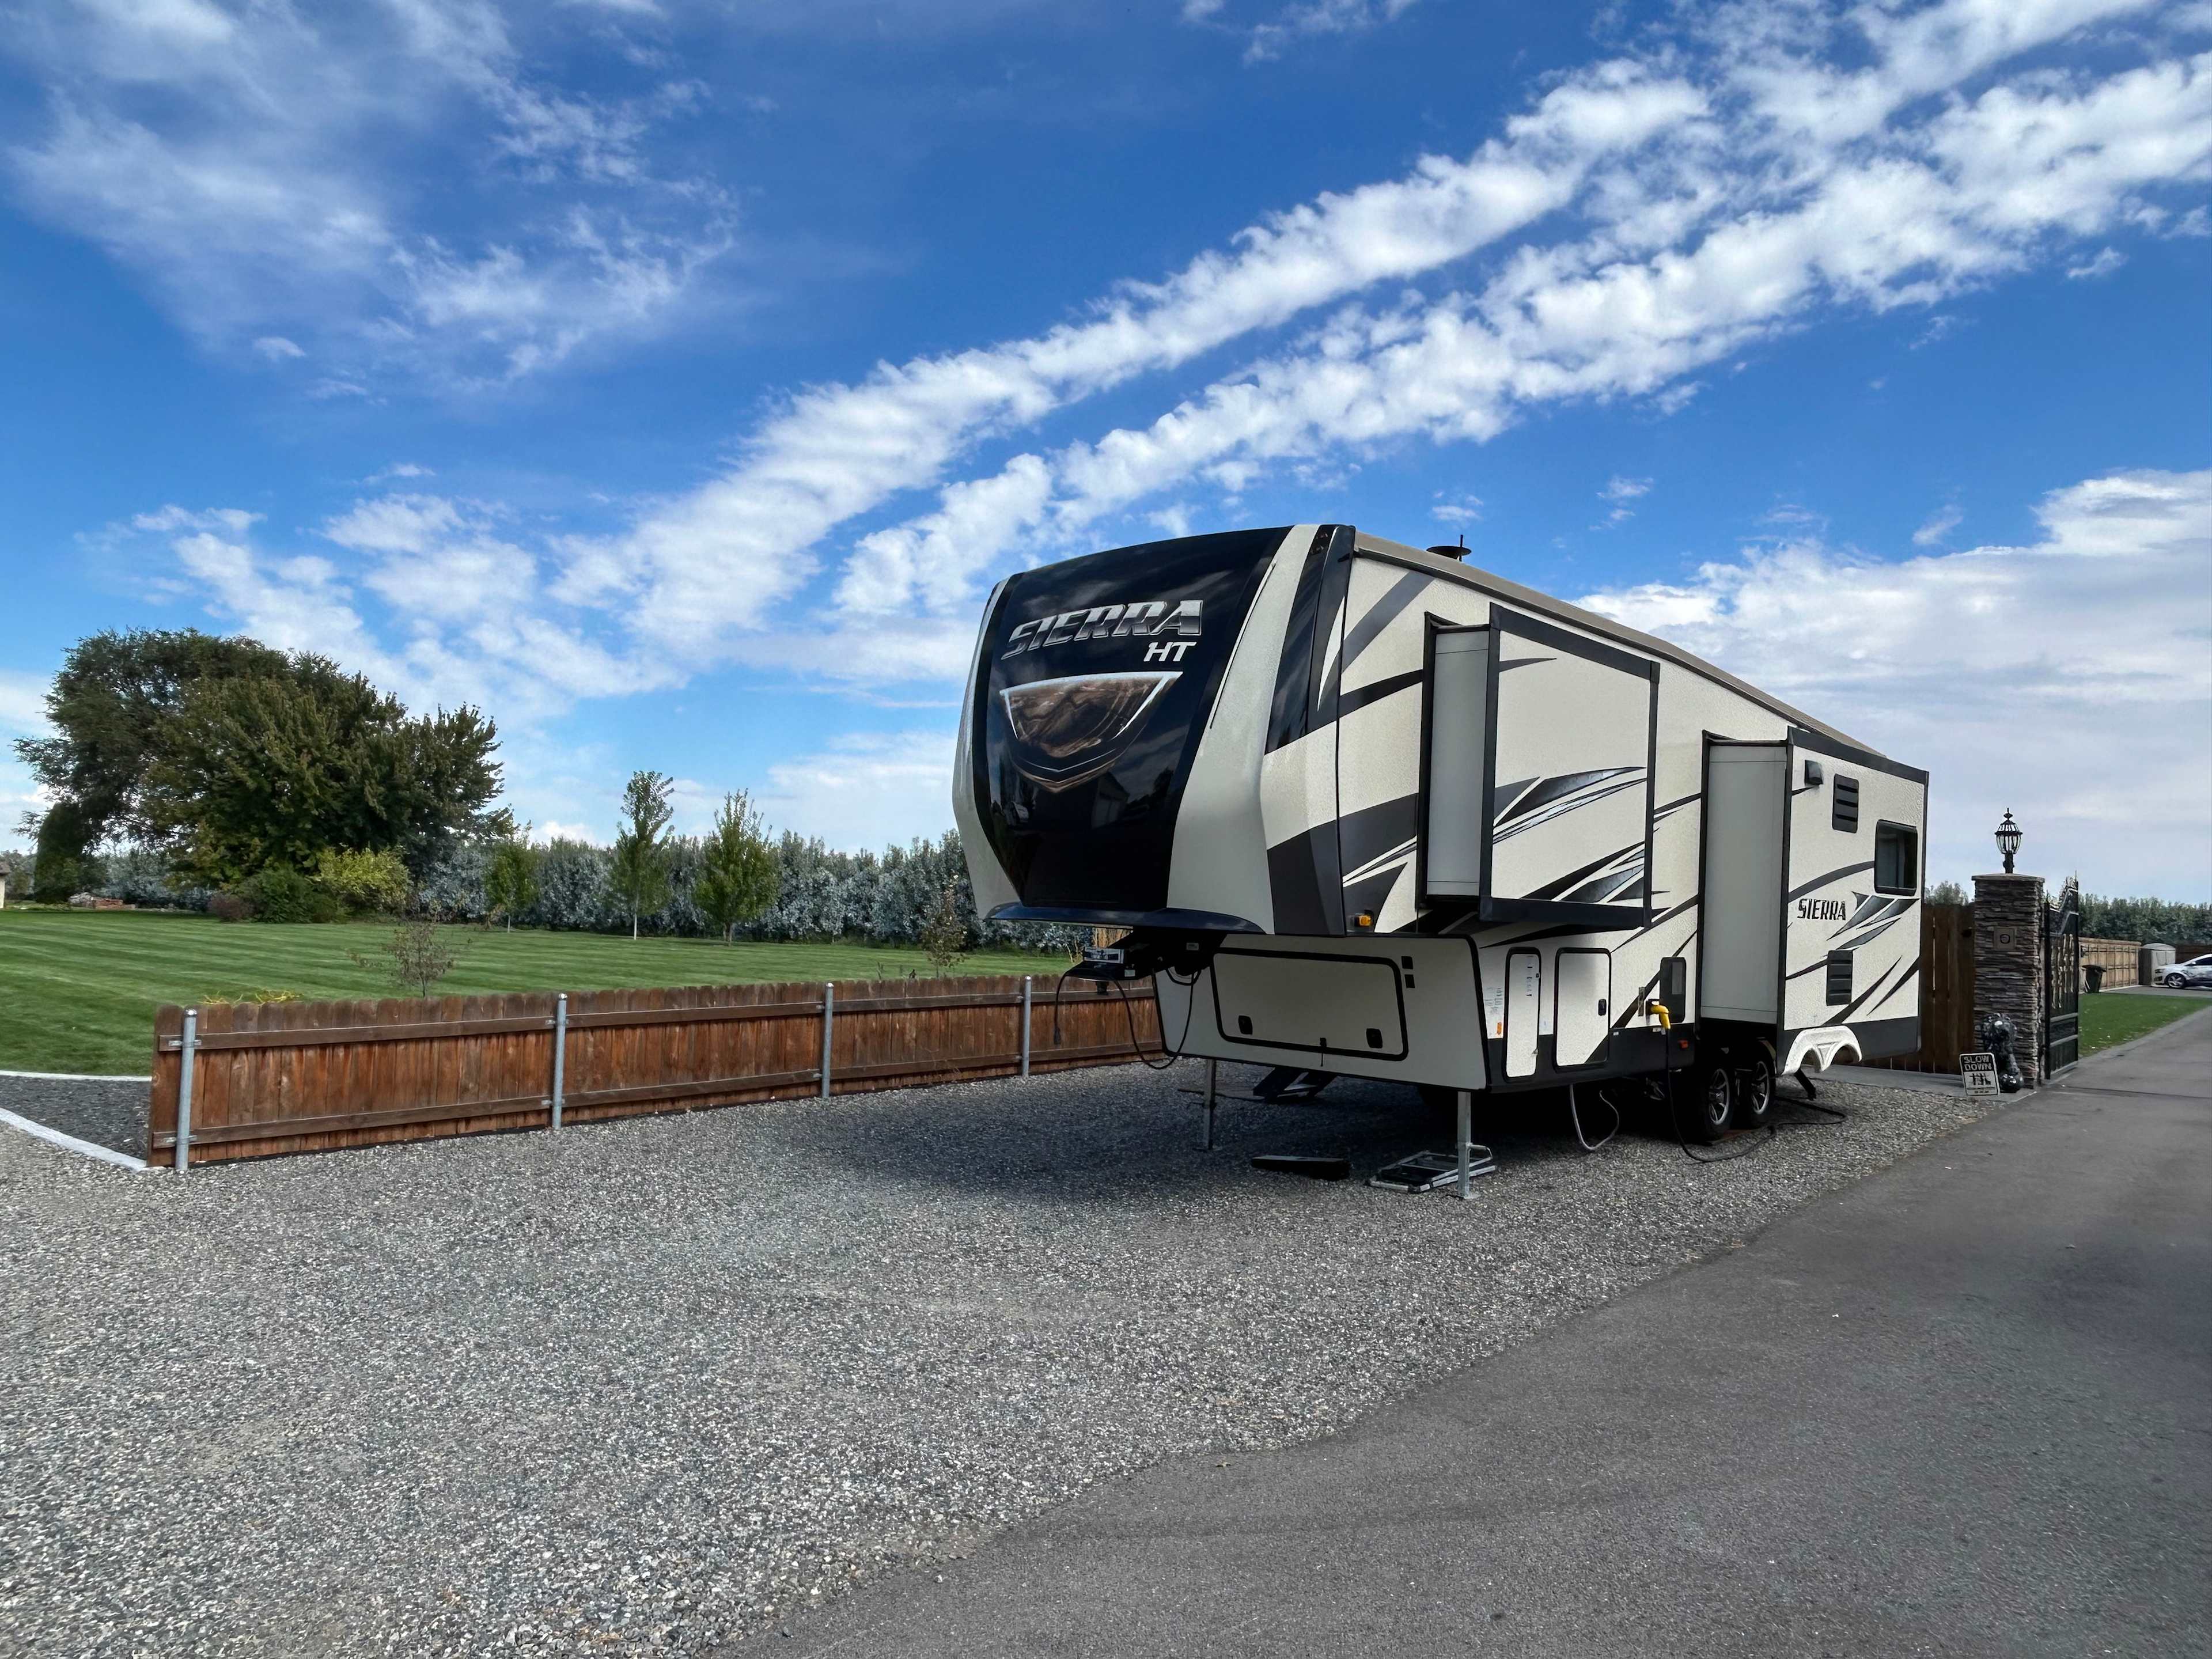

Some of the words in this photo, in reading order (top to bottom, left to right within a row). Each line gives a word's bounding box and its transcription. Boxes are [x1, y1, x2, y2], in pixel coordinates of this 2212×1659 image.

[1001, 600, 1203, 660] SIERRA
[1143, 641, 1196, 662] HT
[1797, 898, 1846, 921] SIERRA
[1964, 1055, 1990, 1063] SLOW
[1964, 1063, 1992, 1071] DOWN
